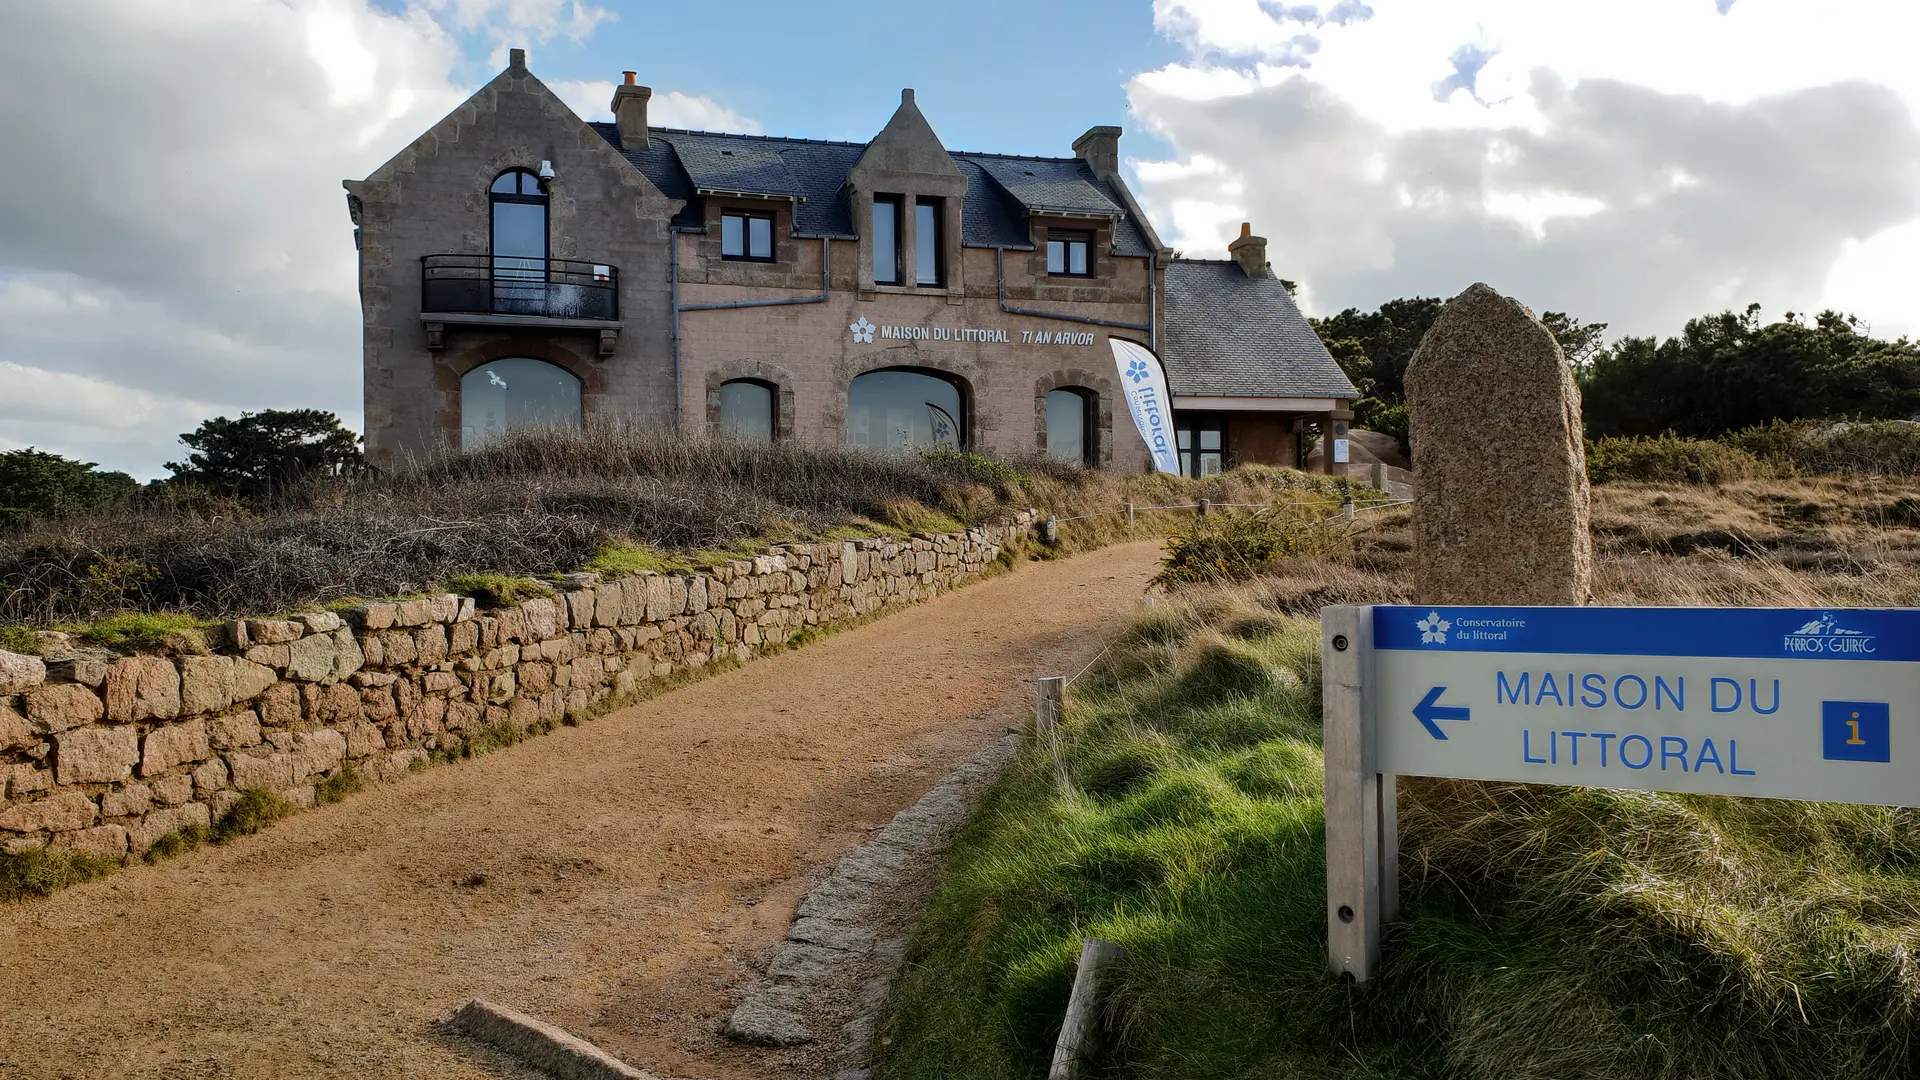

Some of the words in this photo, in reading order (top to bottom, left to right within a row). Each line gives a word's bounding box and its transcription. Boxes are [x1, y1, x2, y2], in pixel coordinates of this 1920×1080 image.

[881, 325, 930, 340] MAISON
[933, 327, 951, 341] DU
[954, 328, 1010, 343] LITTORAL
[1021, 330, 1033, 344] TI
[1034, 331, 1053, 344] AN
[1054, 331, 1095, 345] ARVOR
[1456, 617, 1526, 628] Conservatoire
[1456, 630, 1470, 640] du
[1473, 630, 1507, 641] littoral
[1784, 637, 1876, 654] PERROS-GUIREC
[1496, 671, 1685, 711] MAISON
[1711, 677, 1780, 715] DU
[1845, 711, 1866, 745] i
[1523, 729, 1756, 776] LITTORAL
